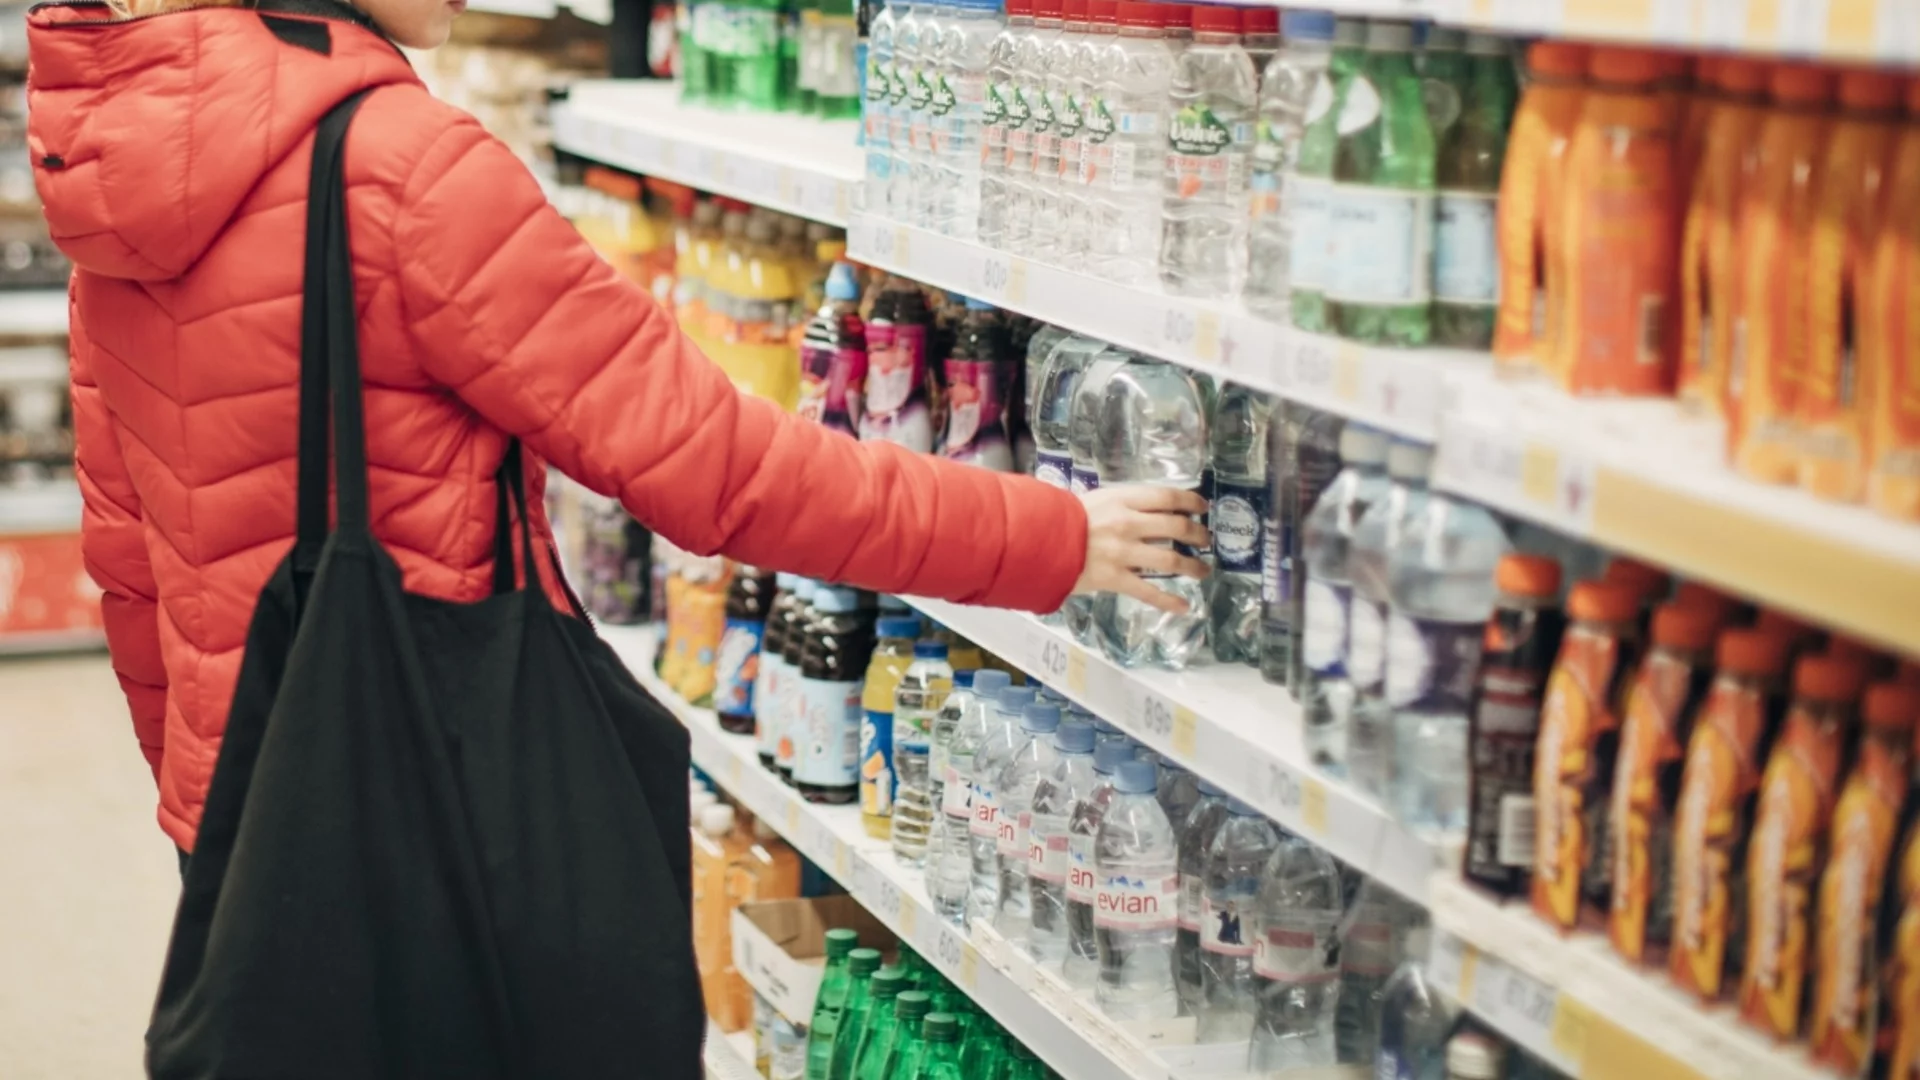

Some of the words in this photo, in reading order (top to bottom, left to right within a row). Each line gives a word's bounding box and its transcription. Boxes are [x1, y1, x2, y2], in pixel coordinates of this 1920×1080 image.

[1262, 517, 1280, 602] smart
[1041, 640, 1067, 677] 42p
[1098, 891, 1158, 914] evian
